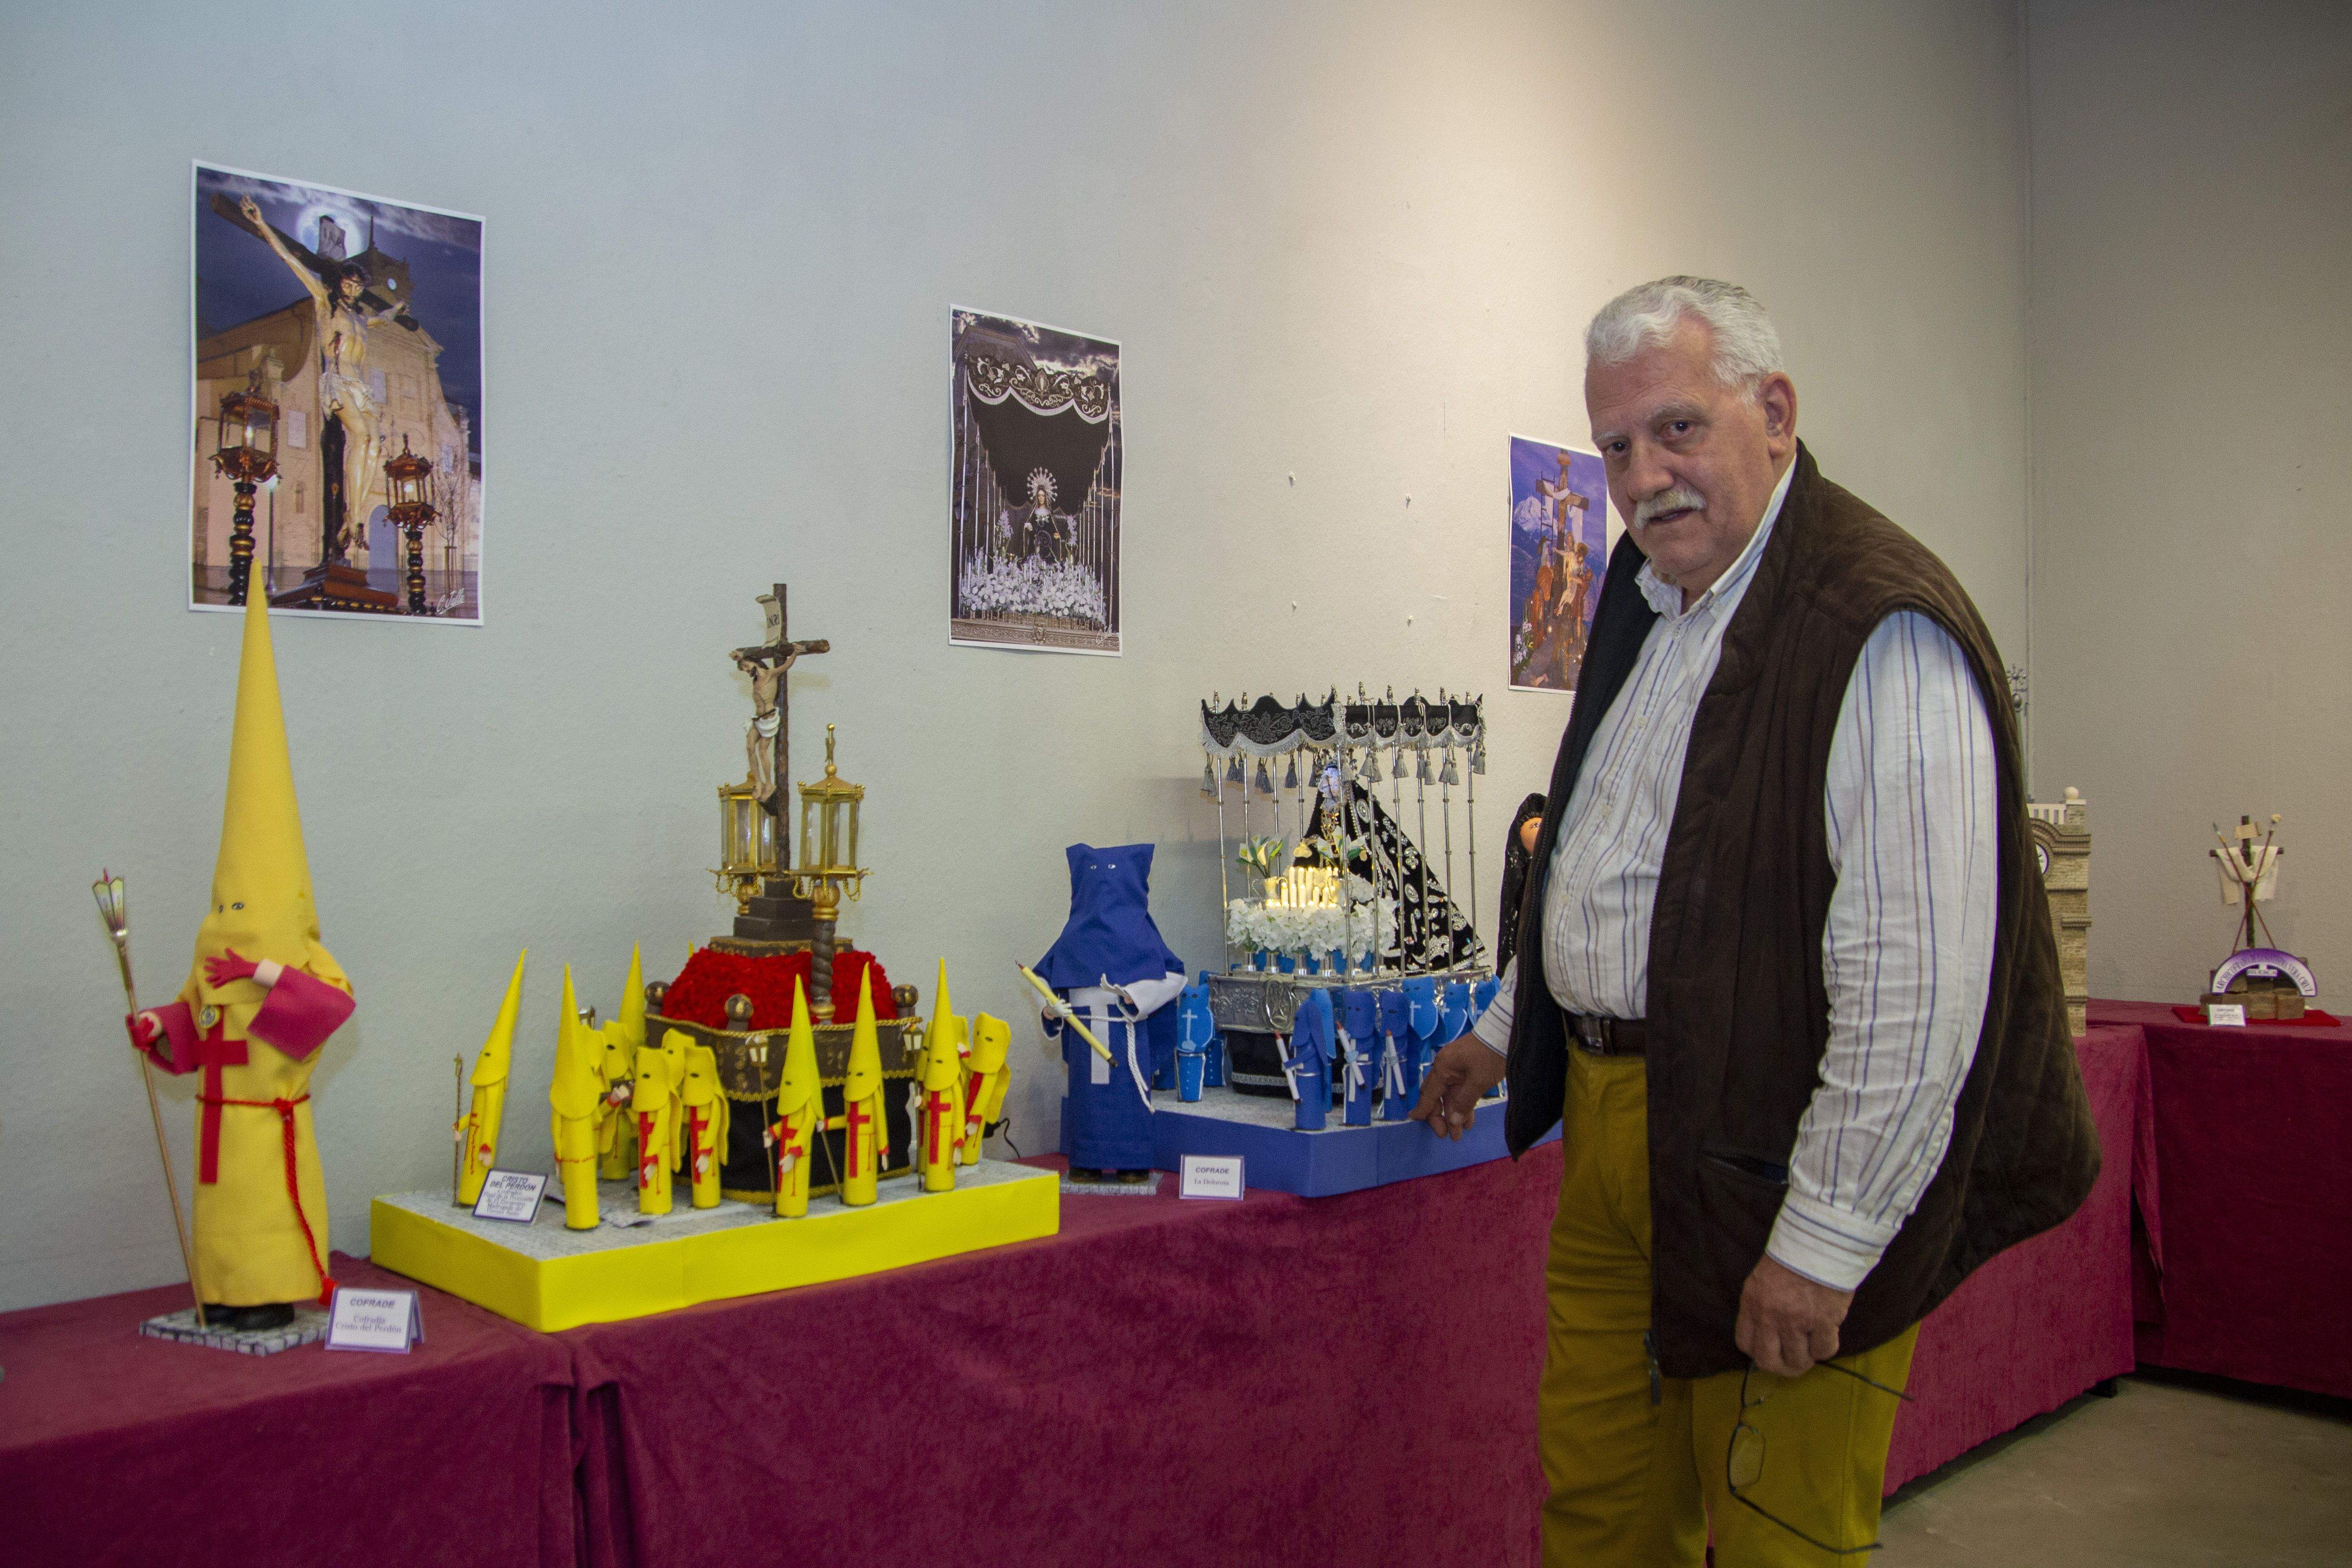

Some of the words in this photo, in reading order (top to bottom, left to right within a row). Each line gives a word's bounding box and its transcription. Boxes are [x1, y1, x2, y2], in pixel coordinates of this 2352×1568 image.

[506, 1182, 536, 1191] PERDÓN
[350, 1298, 396, 1309] COFRADE
[336, 1322, 358, 1331] Cristo
[374, 1325, 402, 1333] Perdón
